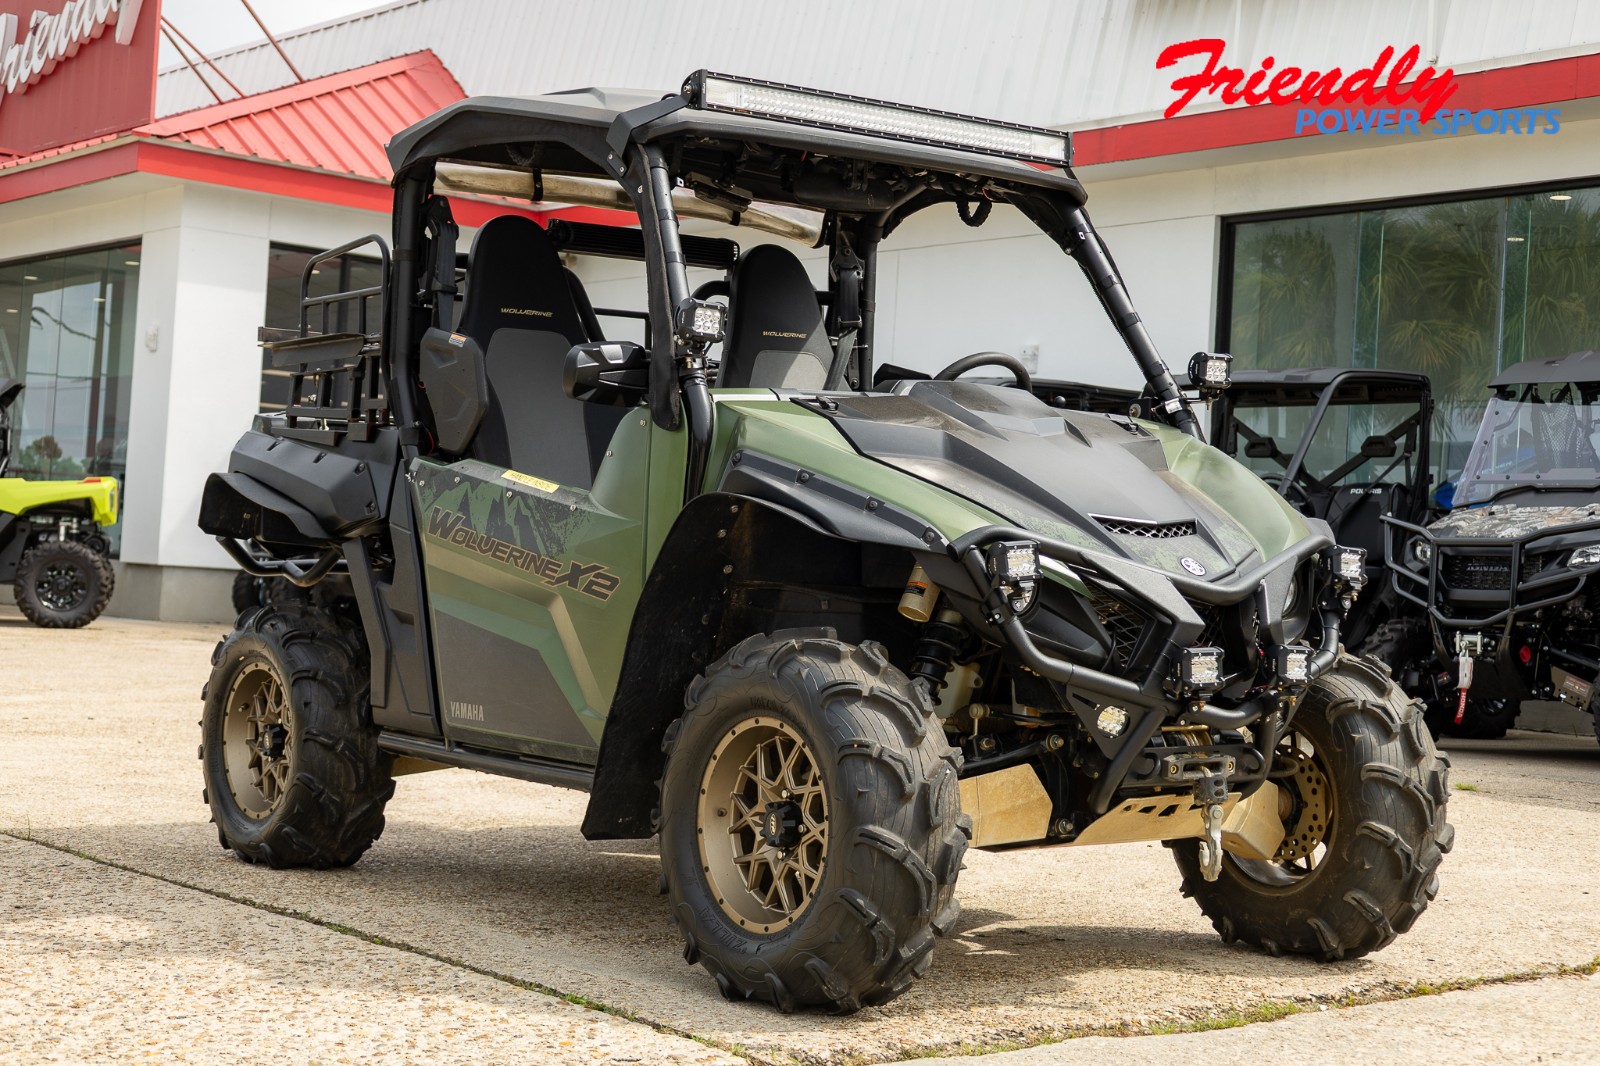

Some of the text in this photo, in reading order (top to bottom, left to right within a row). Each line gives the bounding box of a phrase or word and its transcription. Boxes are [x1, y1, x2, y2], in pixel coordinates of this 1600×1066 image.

[500, 307, 553, 318] WOLVERINE
[762, 330, 808, 339] WOLVERINE
[428, 505, 620, 602] WOLVERINE X2
[450, 701, 485, 722] YAMAHA
[1456, 692, 1467, 719] HONDA
